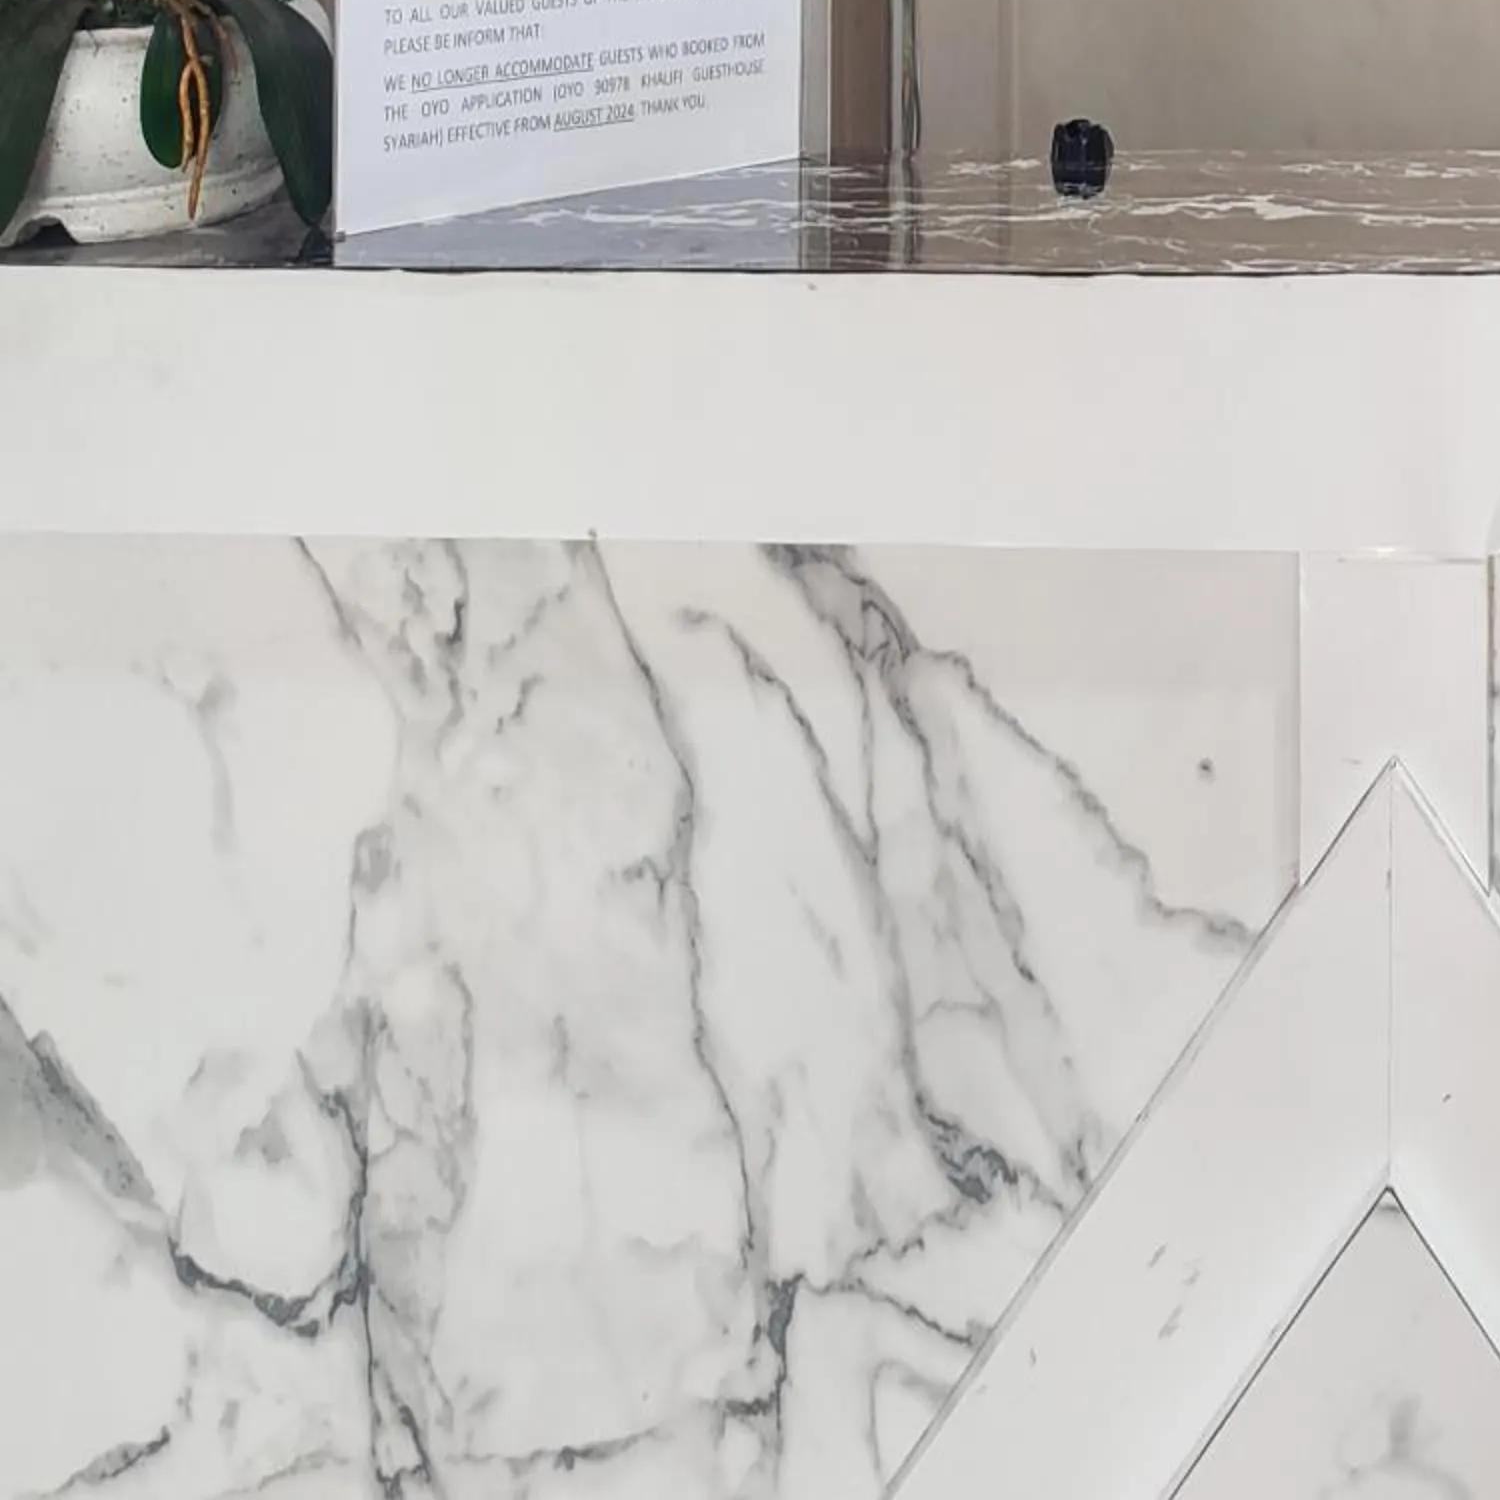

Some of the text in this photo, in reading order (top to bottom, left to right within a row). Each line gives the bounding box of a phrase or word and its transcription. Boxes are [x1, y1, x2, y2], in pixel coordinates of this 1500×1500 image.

[385, 8, 402, 25] TO
[410, 6, 432, 24] ALL
[440, 2, 469, 20] OUR
[385, 34, 430, 55] PLEASE
[434, 33, 450, 50] BE
[453, 27, 505, 49] INFORM
[385, 32, 766, 93] WE NO LONGER ACCOMMODATE GUESTS WHO BOOKED FROM
[385, 104, 408, 122] THE
[421, 99, 450, 117] OYO
[461, 87, 542, 112] APPLICATION
[594, 76, 630, 96] 90978
[692, 58, 765, 82] GUESTHOUSE
[447, 119, 511, 143] EFFECTIVE
[514, 114, 550, 133] FROM
[554, 107, 601, 130] AUGUST
[640, 98, 679, 116] THANK
